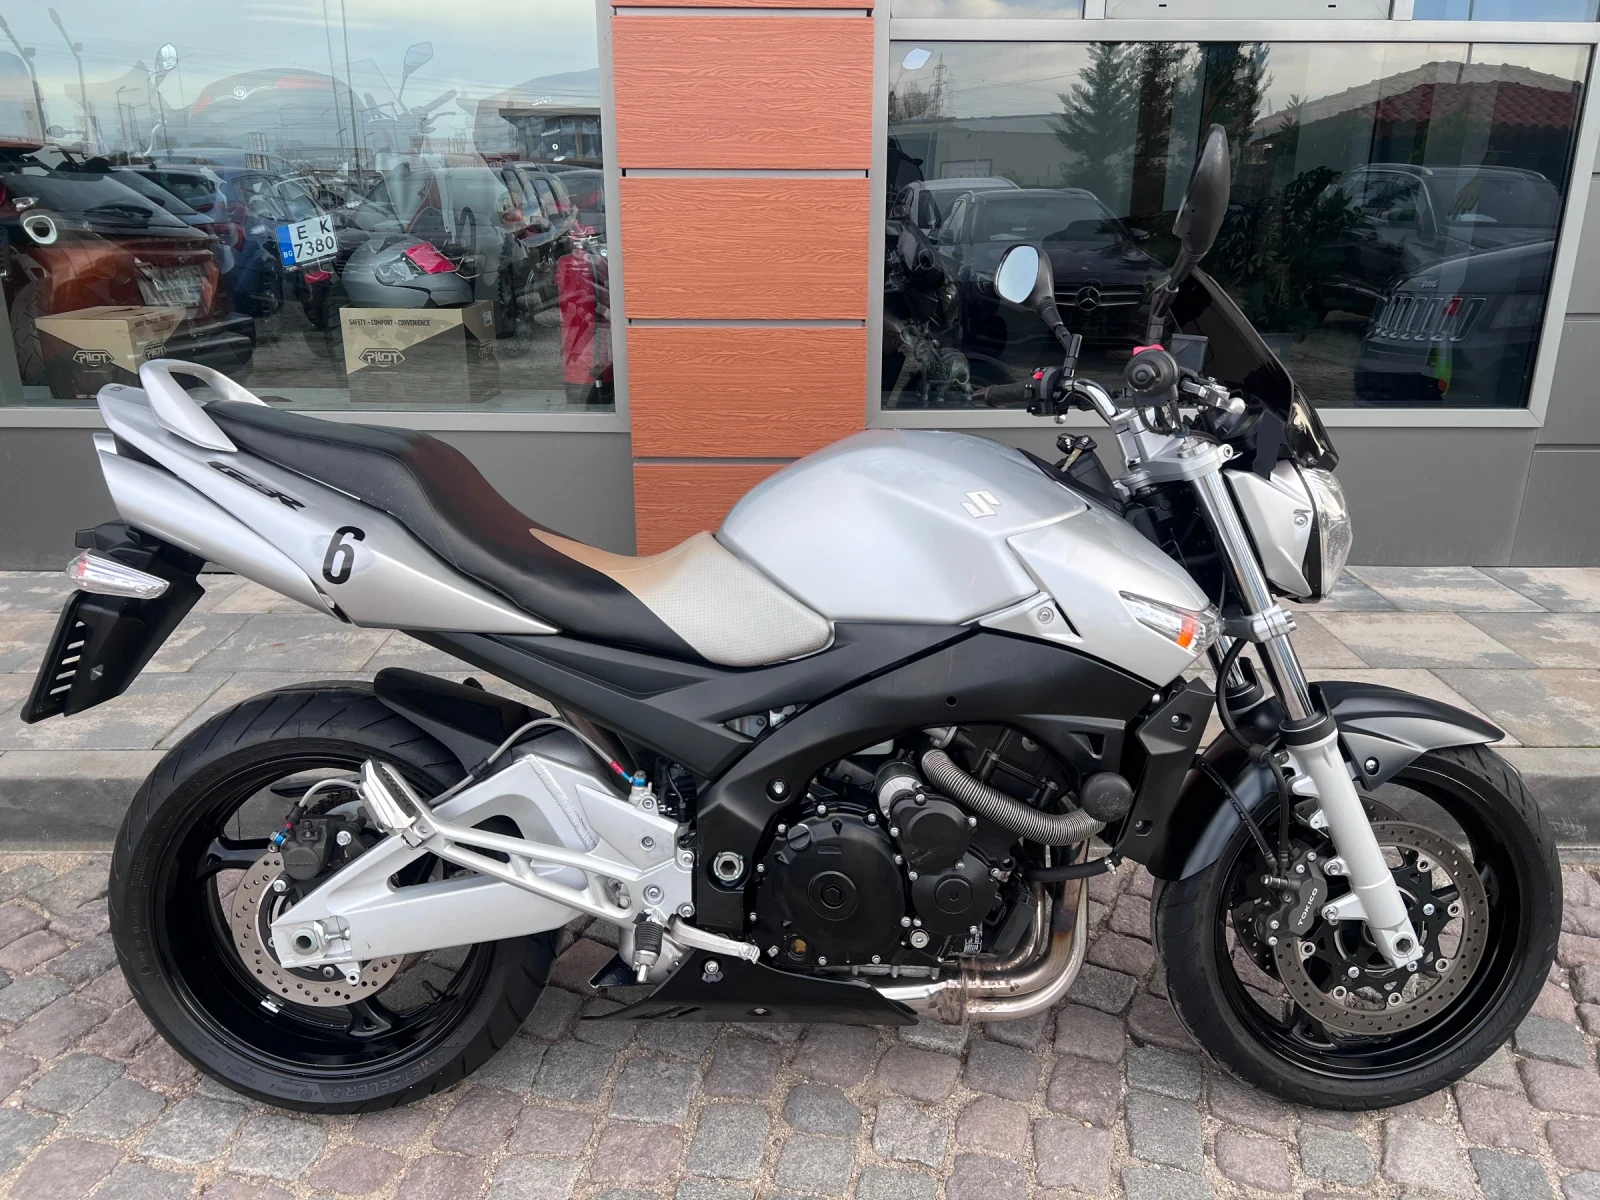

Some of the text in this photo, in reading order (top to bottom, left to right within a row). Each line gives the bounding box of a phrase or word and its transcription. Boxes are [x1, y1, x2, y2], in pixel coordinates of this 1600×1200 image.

[296, 219, 332, 241] E K
[283, 250, 293, 259] BG
[293, 235, 335, 259] 7380
[398, 319, 431, 327] CONVENIENCE
[322, 525, 366, 585] 6
[1297, 887, 1319, 926] TOKICO
[345, 1057, 438, 1097] METZELER
